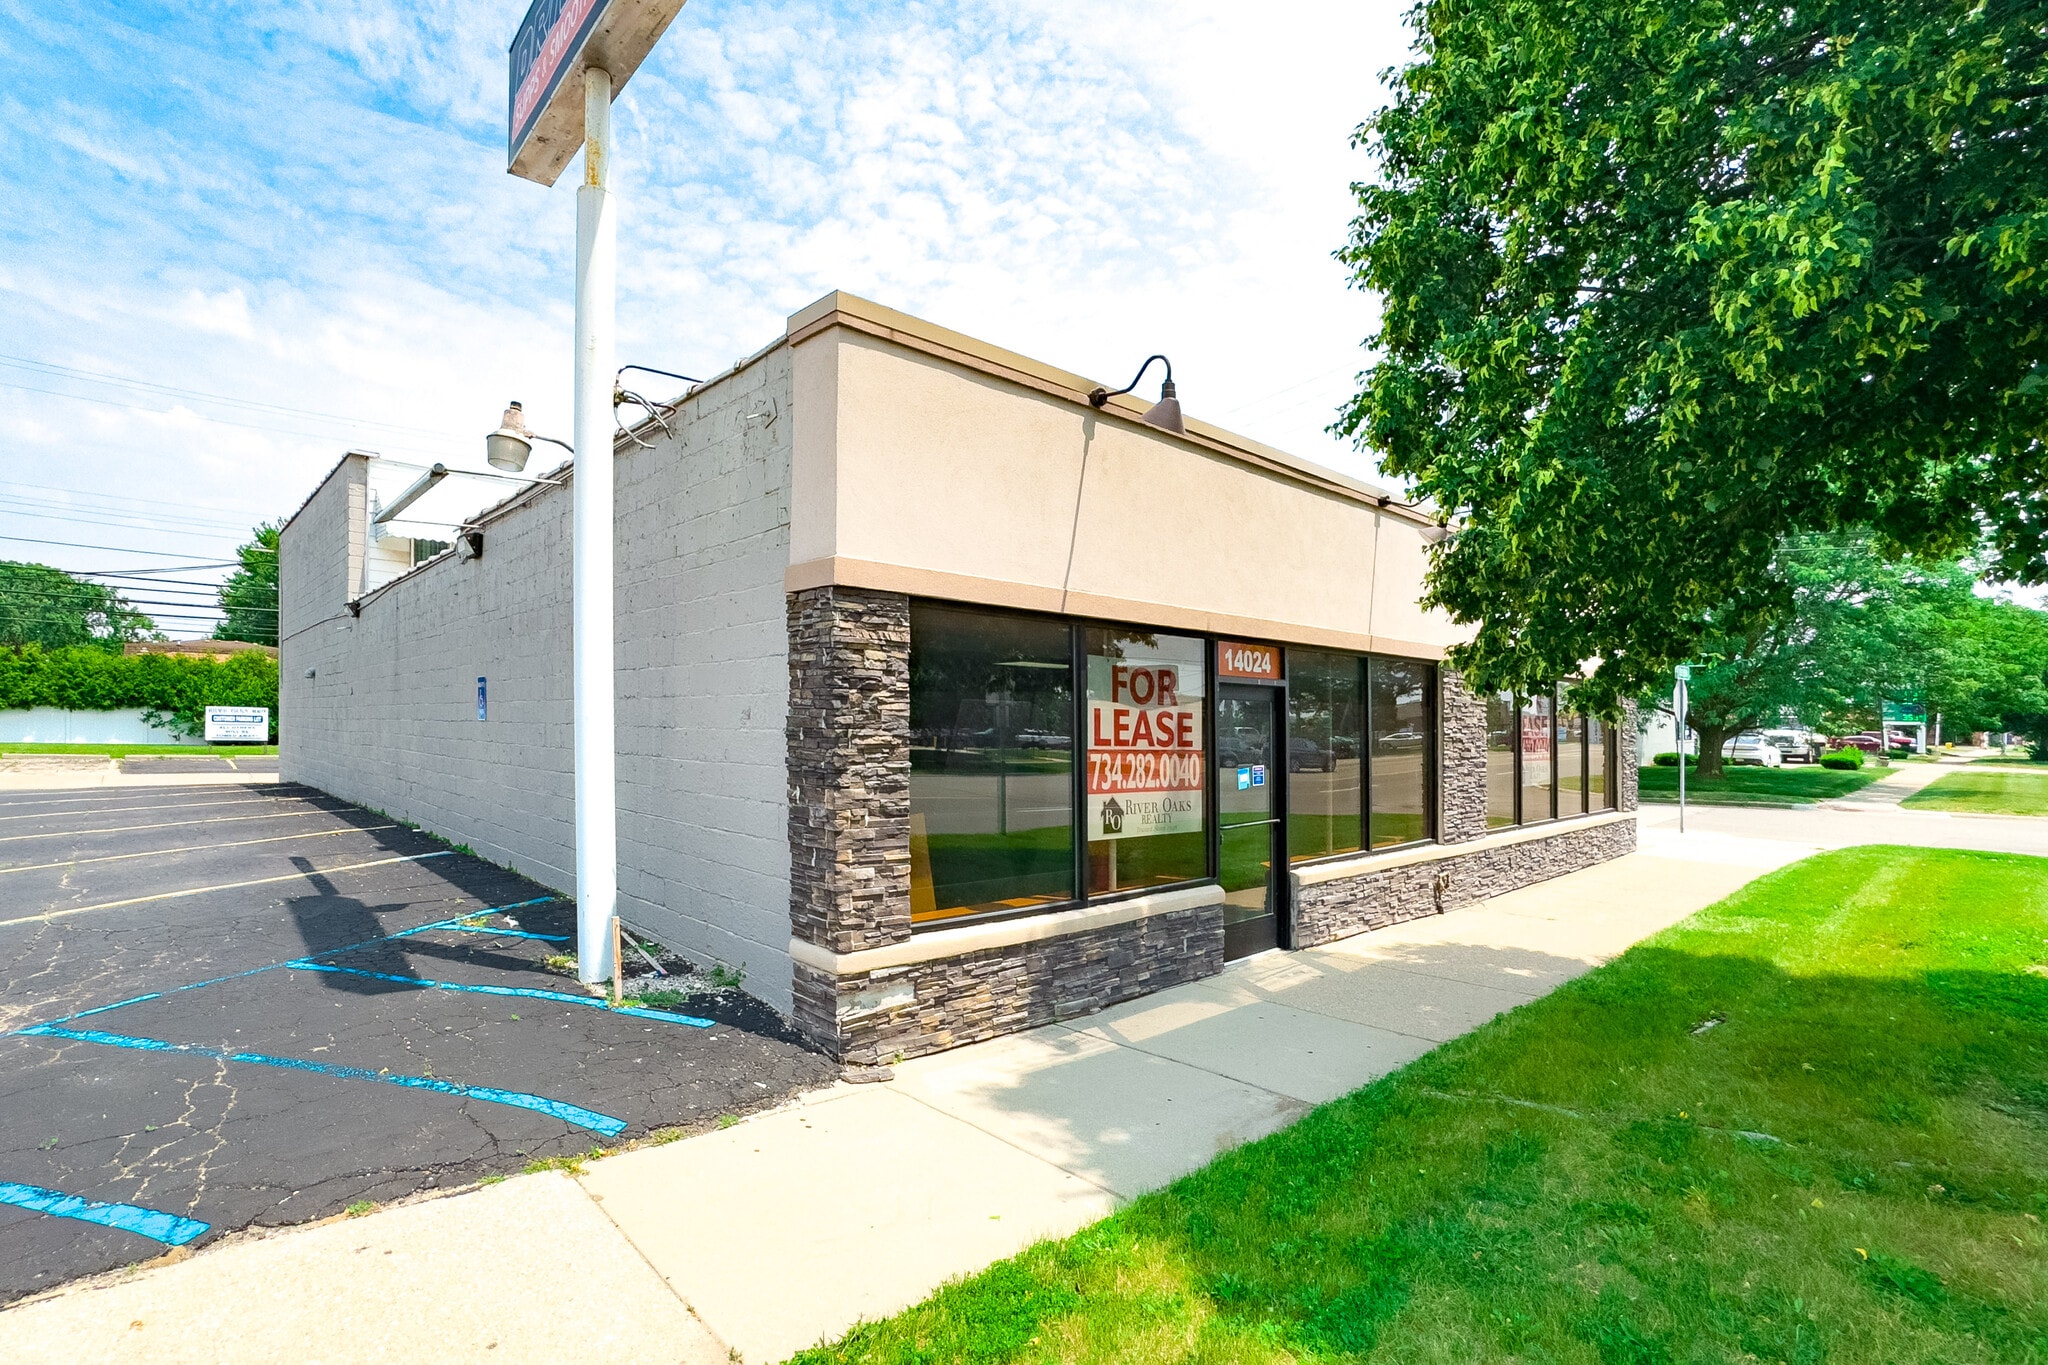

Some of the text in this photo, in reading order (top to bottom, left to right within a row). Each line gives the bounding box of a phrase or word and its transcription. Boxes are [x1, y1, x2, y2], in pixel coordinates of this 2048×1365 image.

[549, 0, 587, 66] SMOO
[1224, 648, 1271, 673] 14024
[1111, 664, 1178, 706] FOR
[1093, 707, 1193, 747] LEASE
[1090, 752, 1200, 791] 734.282.0040
[1125, 797, 1192, 815] RIVER OAKS
[1141, 813, 1172, 825] REALTY
